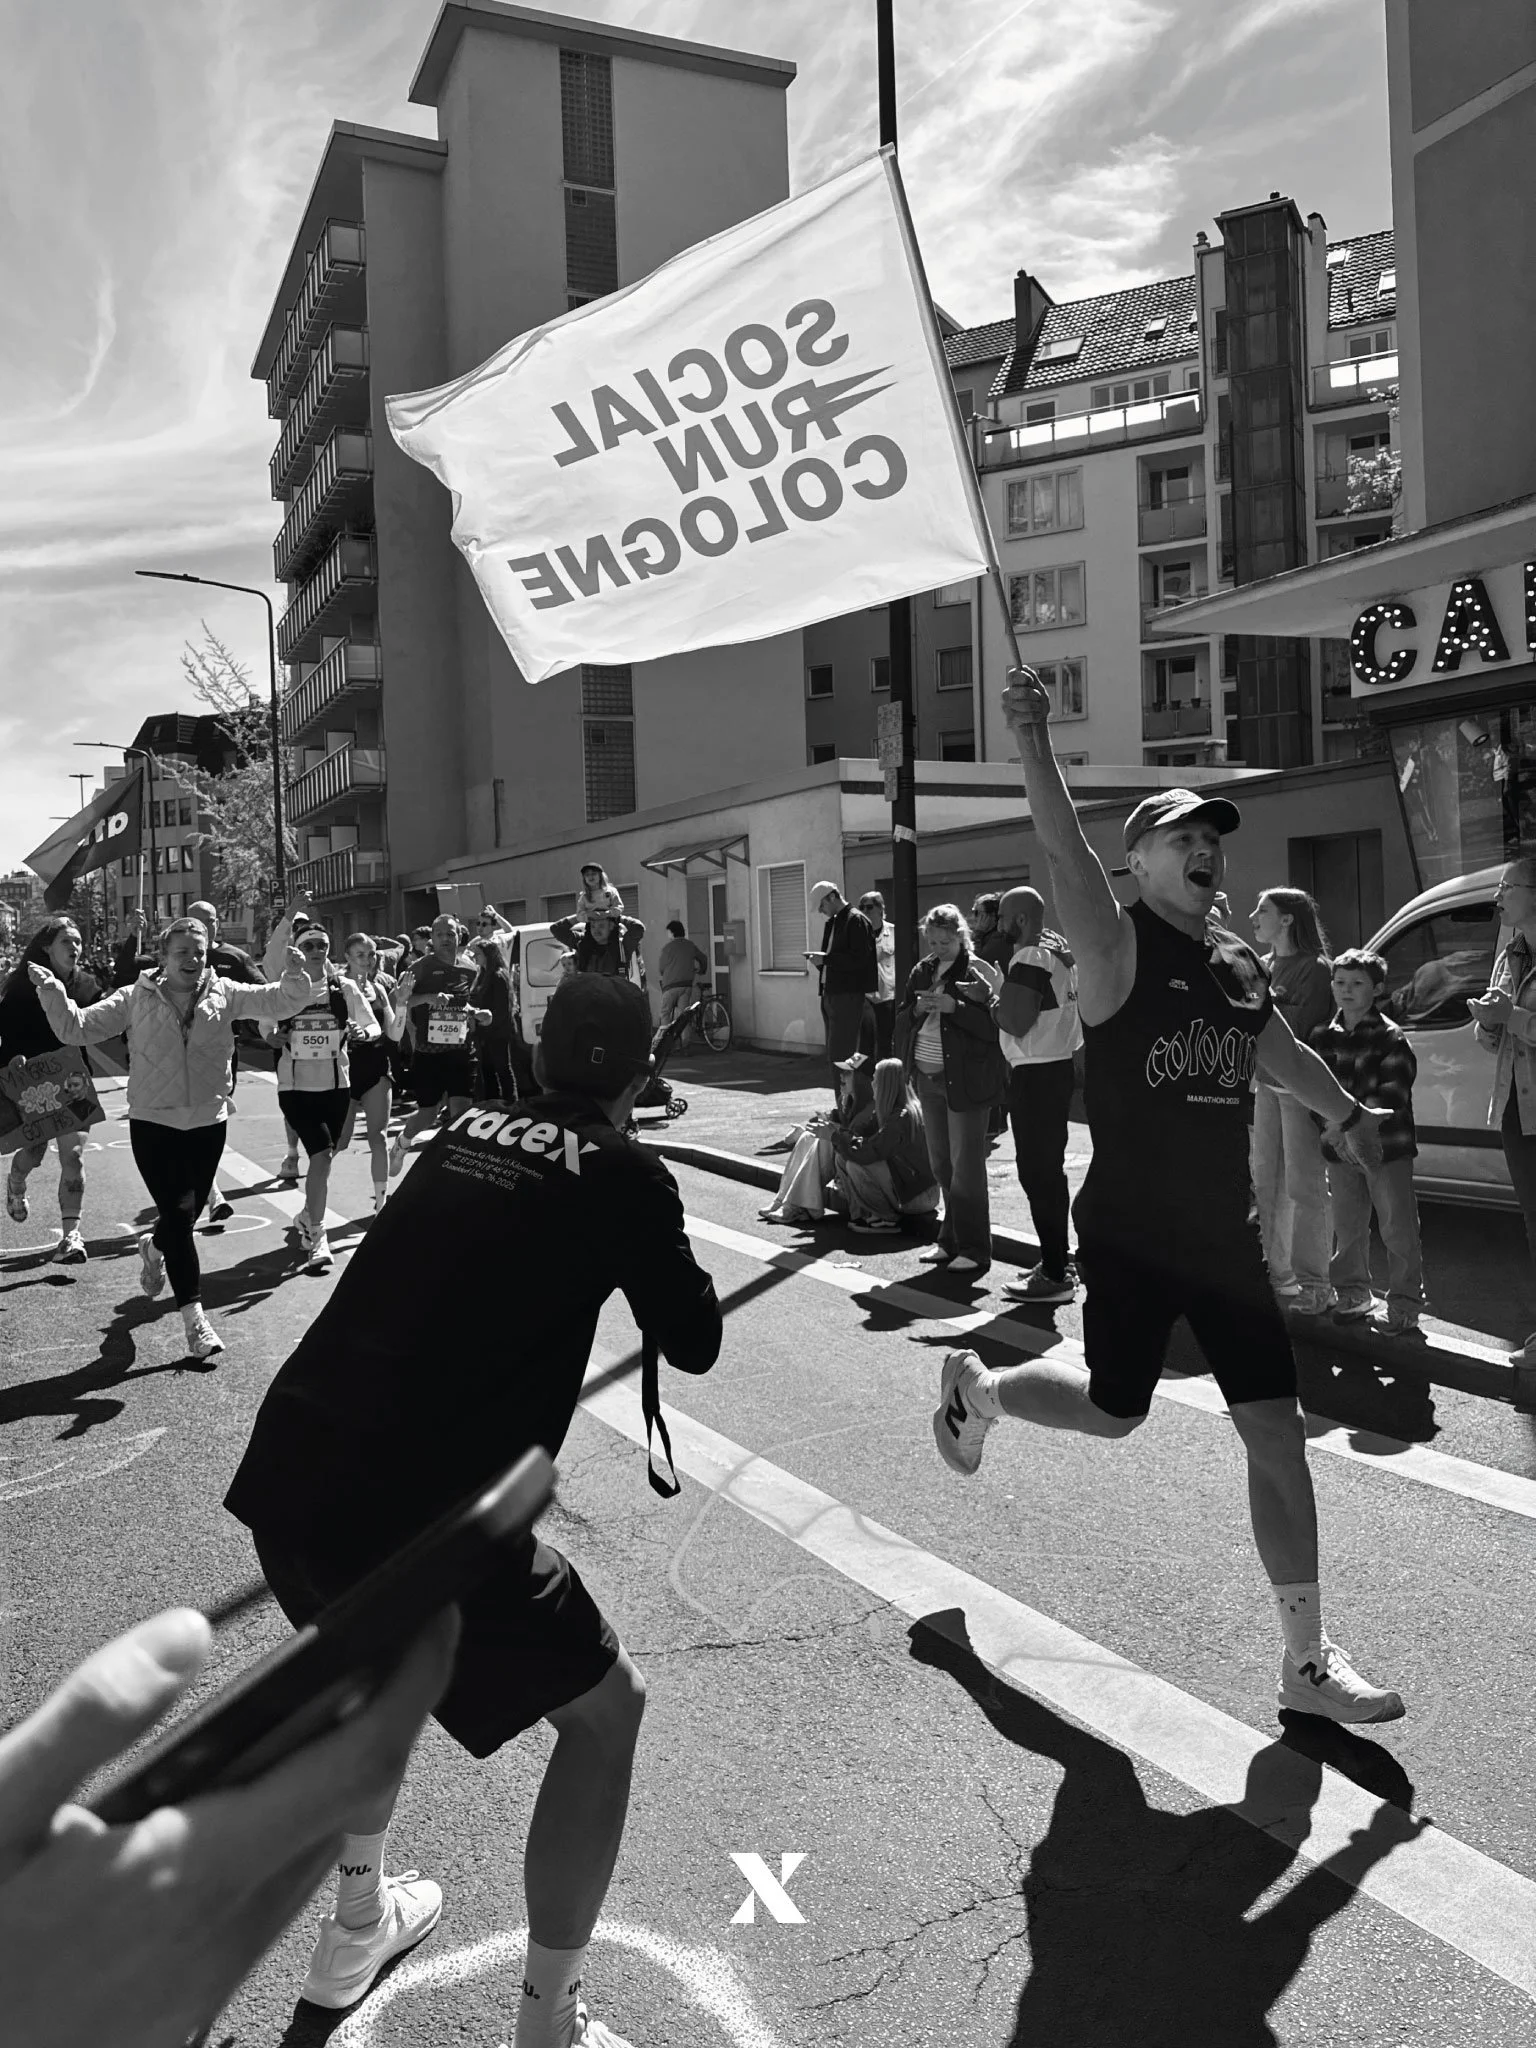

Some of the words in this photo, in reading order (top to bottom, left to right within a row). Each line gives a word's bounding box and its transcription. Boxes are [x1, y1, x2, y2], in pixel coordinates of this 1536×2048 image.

[1350, 561, 1536, 685] CA
[436, 1024, 459, 1033] 4256
[302, 1035, 329, 1045] 5501
[1146, 1018, 1257, 1088] cologn
[1186, 1094, 1226, 1104] MARATHON
